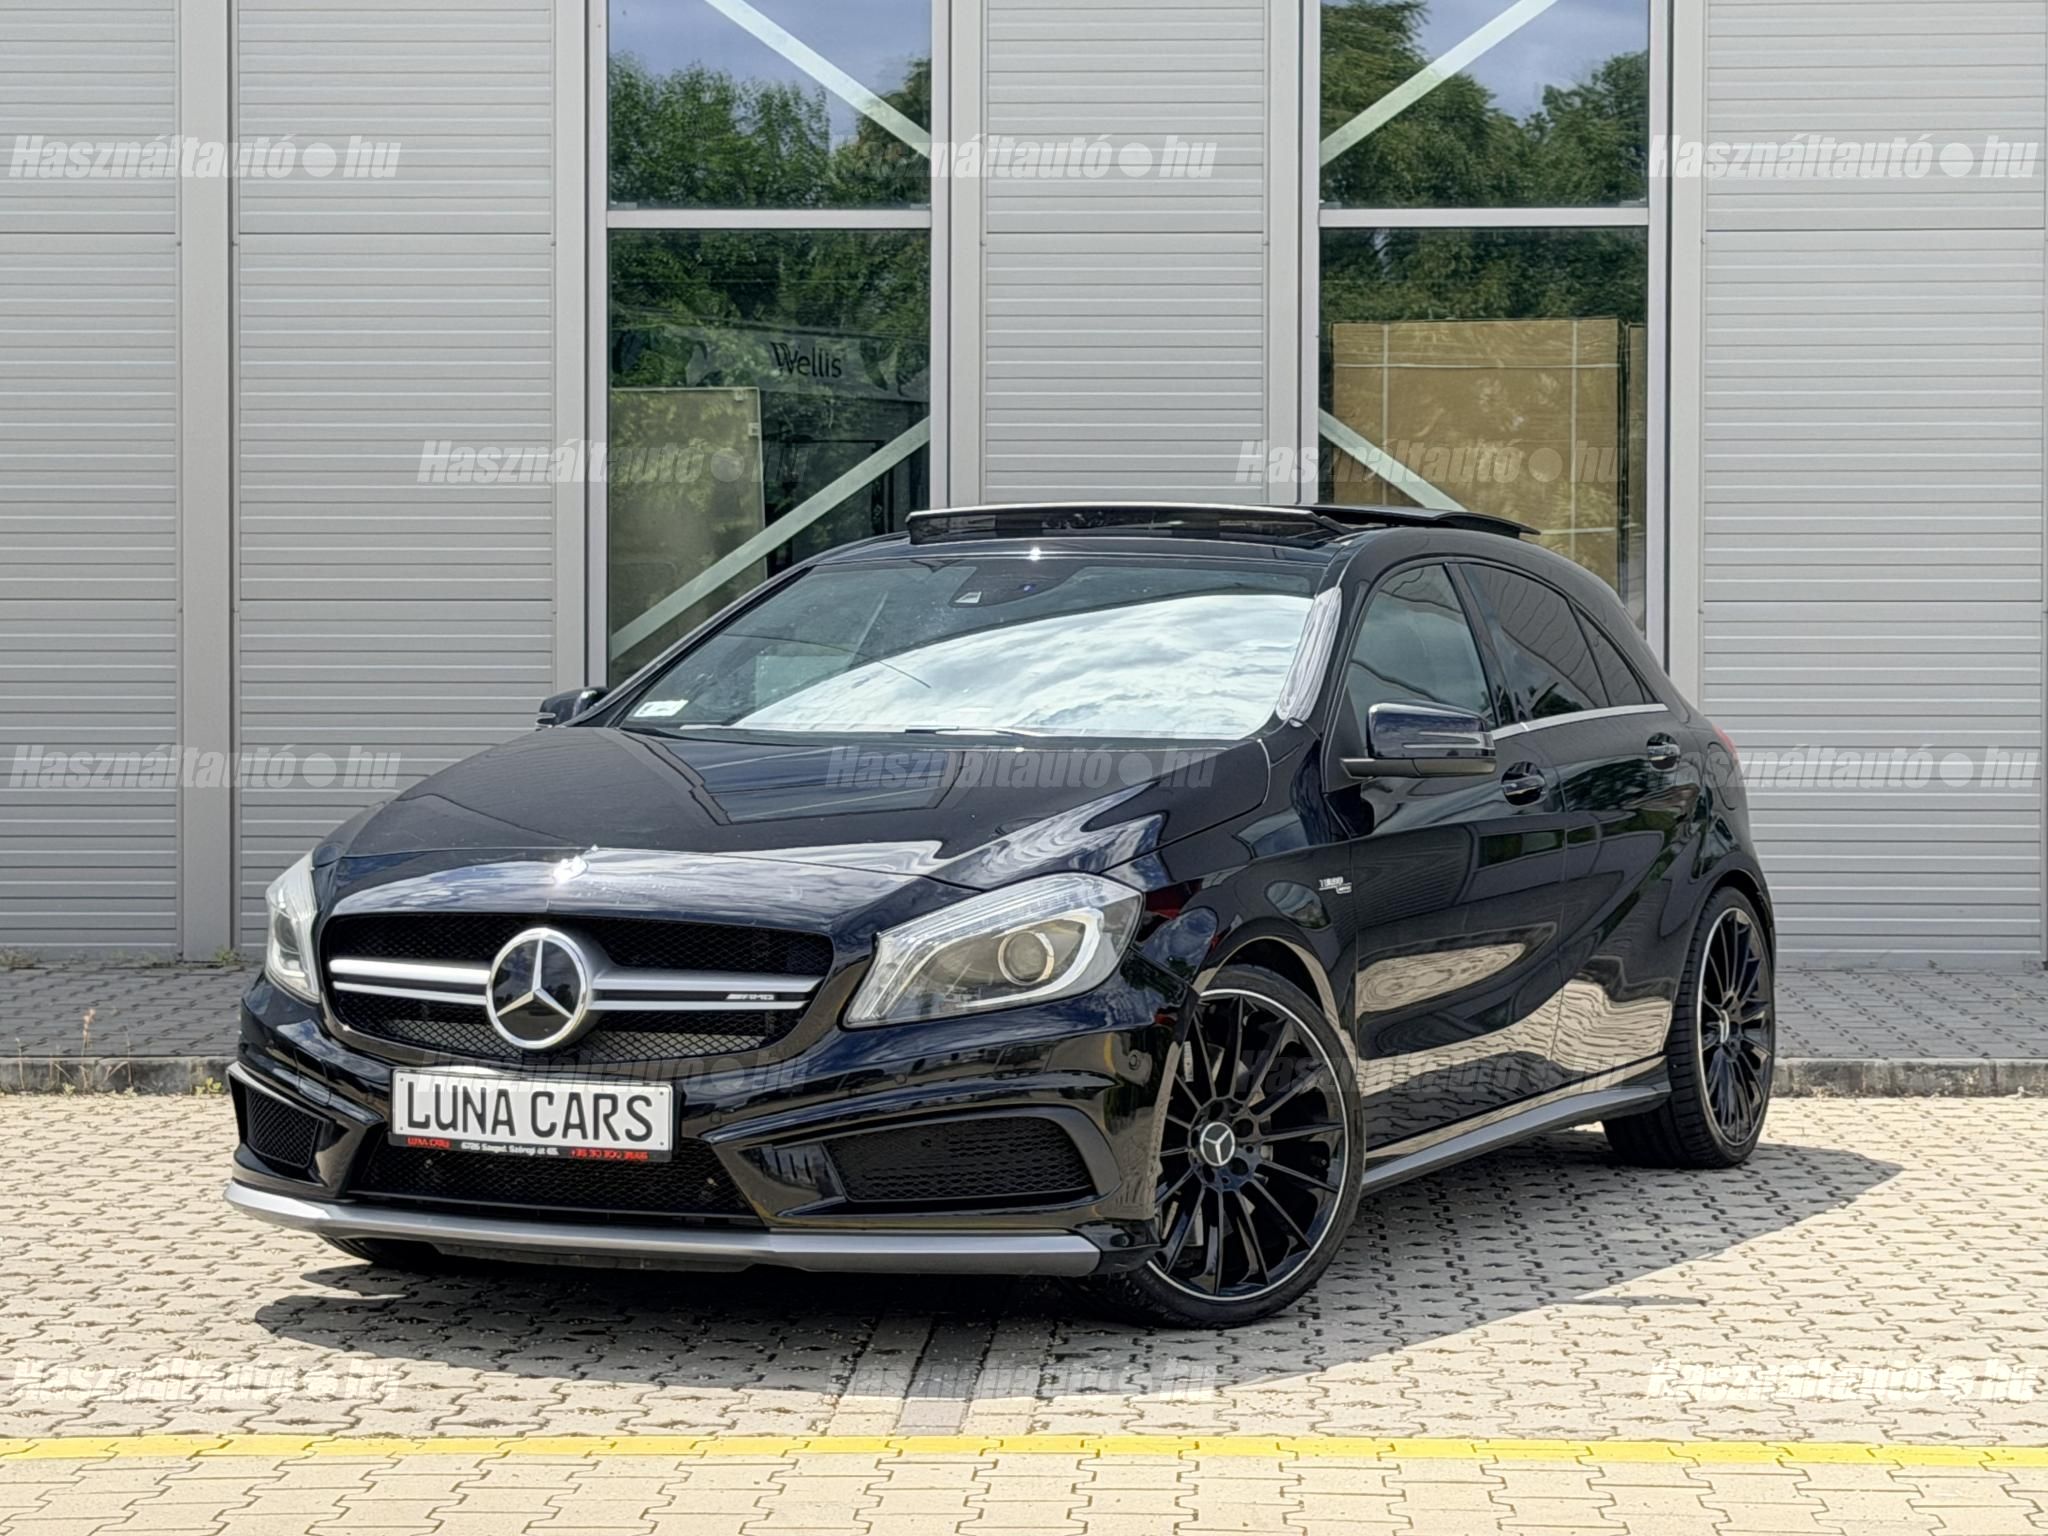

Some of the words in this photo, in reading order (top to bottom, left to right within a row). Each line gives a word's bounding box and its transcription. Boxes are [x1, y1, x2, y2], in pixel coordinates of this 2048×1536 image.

[770, 342, 842, 378] Wellis
[407, 1081, 516, 1136] LUNA
[530, 1090, 653, 1142] CARS
